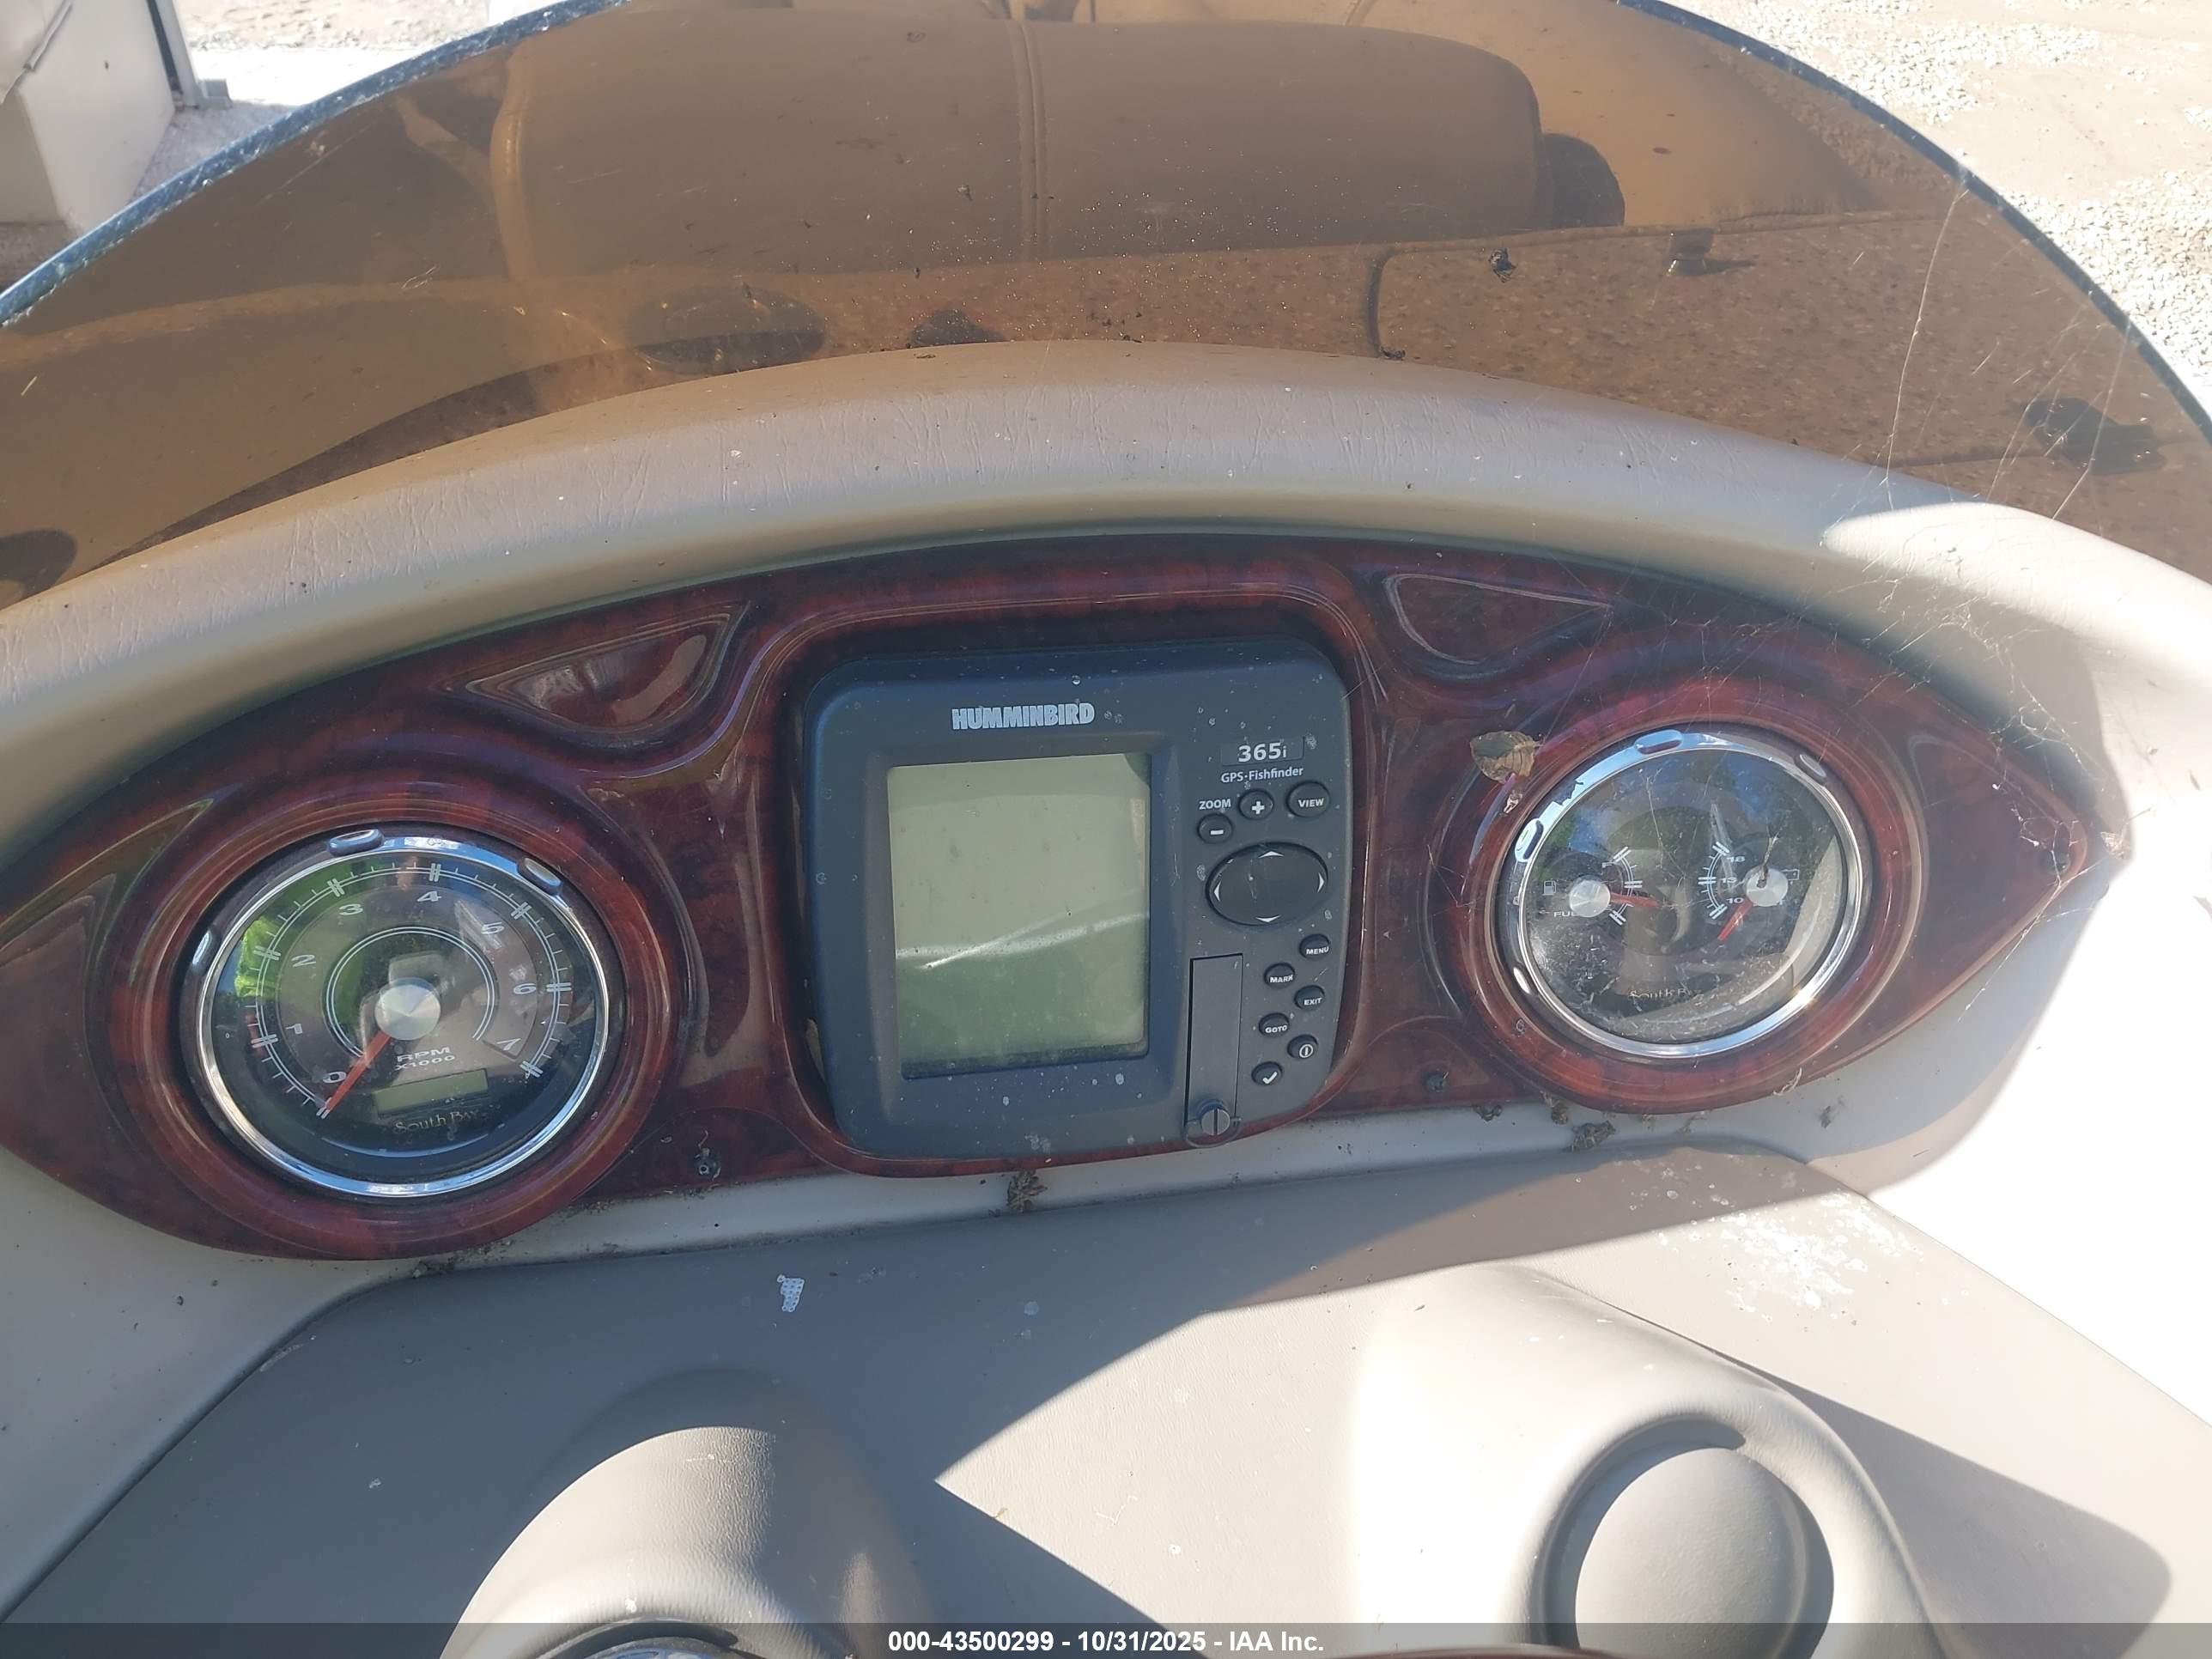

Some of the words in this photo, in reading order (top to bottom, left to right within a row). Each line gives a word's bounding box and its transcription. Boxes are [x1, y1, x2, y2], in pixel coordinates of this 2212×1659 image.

[951, 702, 1096, 730] HUMMINBIRD
[1237, 742, 1287, 763] 365i
[1199, 799, 1231, 811] ZOOM
[1297, 798, 1325, 808] VIEW
[416, 890, 443, 902] 4
[338, 903, 364, 916] 3
[481, 921, 505, 935] 5
[1306, 945, 1330, 956] MENU
[291, 954, 317, 968] 2
[1269, 975, 1294, 984] MARK
[513, 982, 537, 995] 6
[1304, 997, 1323, 1006] EXIT
[285, 1023, 303, 1035] 1
[1265, 1024, 1288, 1034] GOTO
[495, 1036, 523, 1052] 7
[397, 1046, 452, 1063] RPM
[322, 1071, 348, 1084] 0
[394, 1114, 447, 1131] South
